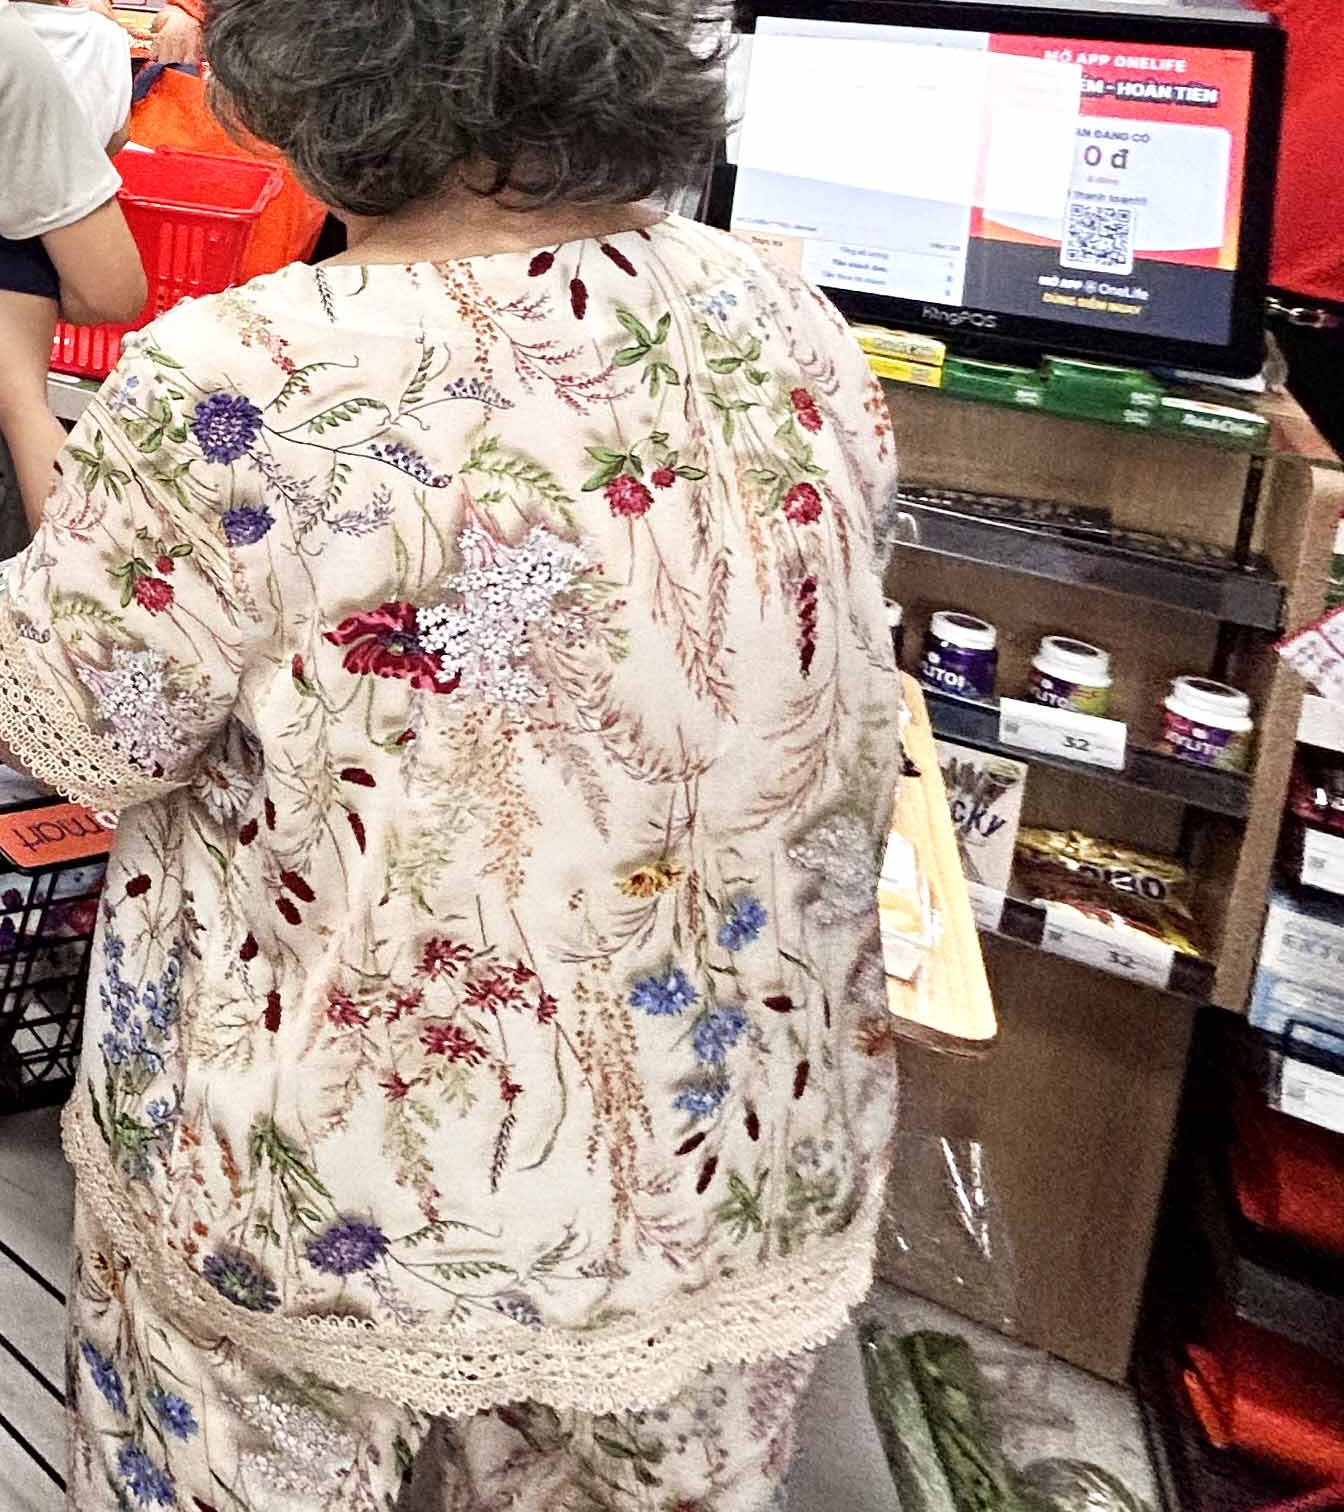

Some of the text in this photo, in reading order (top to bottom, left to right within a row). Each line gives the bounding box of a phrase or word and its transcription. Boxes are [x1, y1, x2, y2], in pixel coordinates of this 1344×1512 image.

[1076, 53, 1110, 67] APP
[1114, 57, 1188, 74] ONELIFE
[1084, 145, 1129, 170] 0 đ
[1063, 737, 1090, 752] 32
